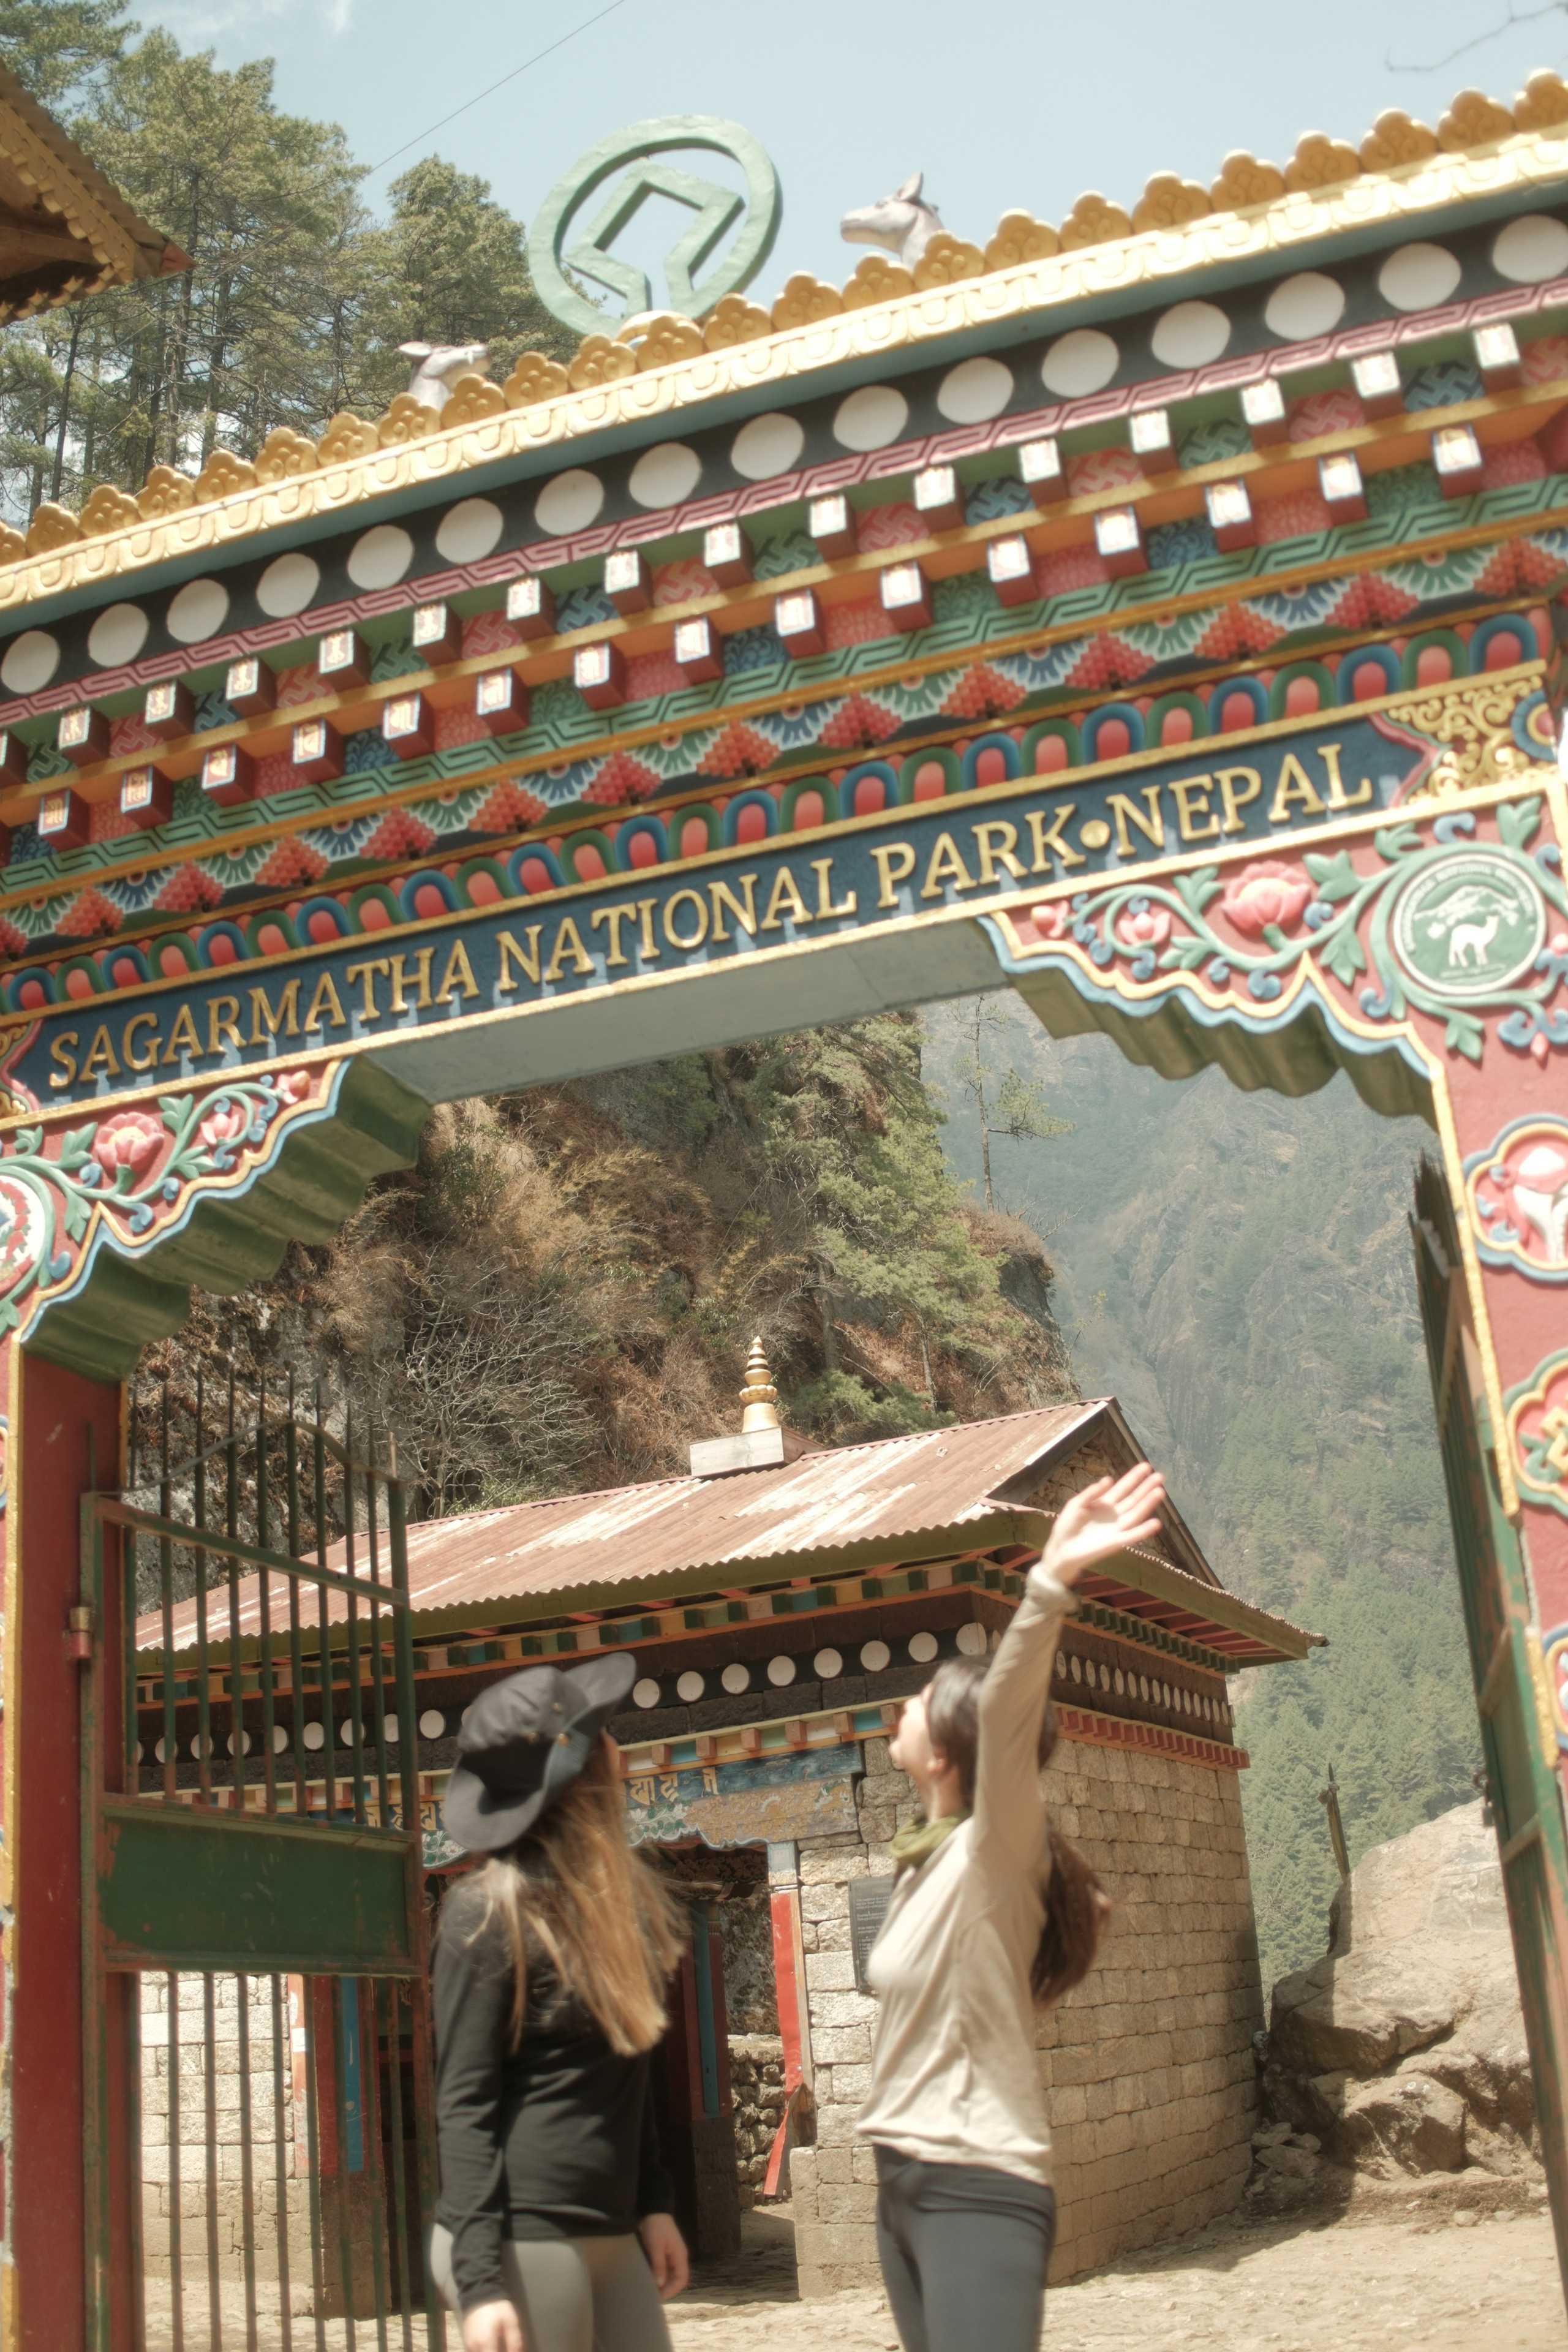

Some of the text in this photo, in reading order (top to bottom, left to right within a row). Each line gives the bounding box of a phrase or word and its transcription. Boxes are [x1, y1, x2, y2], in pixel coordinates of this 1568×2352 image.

[48, 743, 1373, 1089] SAGARMATHA NATIONAL PARK NEPAL
